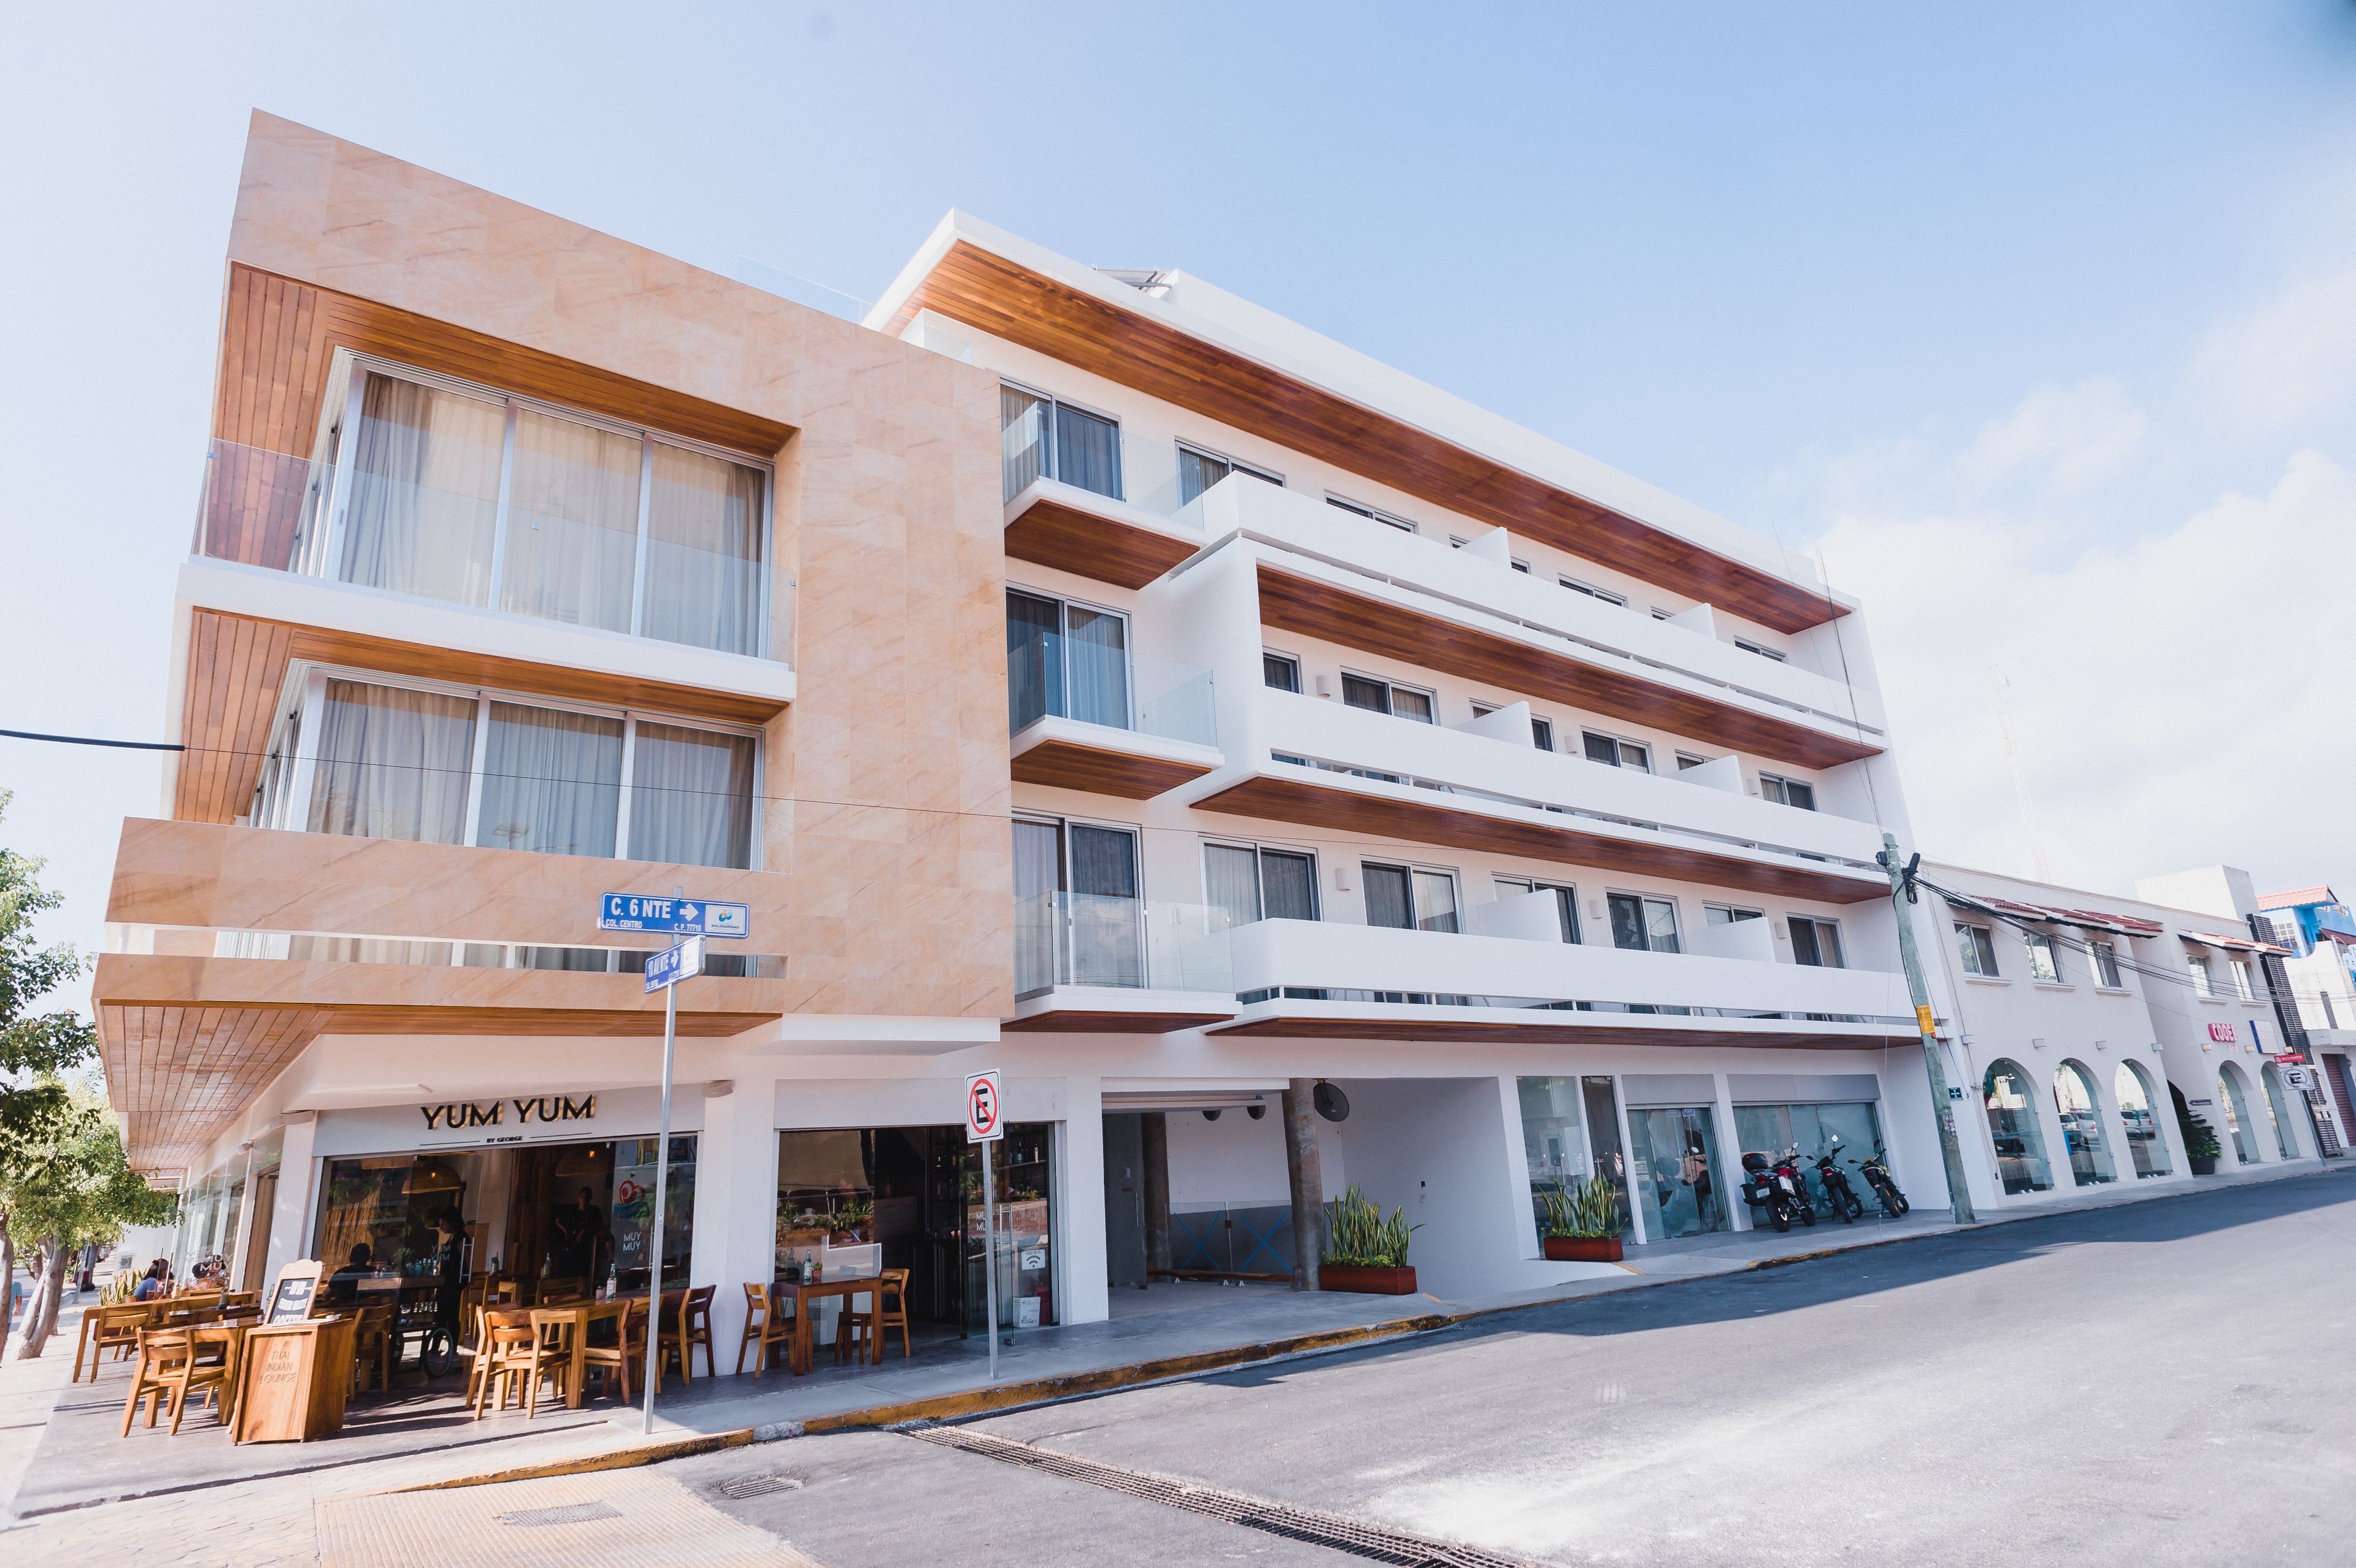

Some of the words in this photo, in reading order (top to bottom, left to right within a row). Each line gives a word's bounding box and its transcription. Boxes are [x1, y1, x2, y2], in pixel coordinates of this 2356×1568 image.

[611, 897, 624, 915] C.
[629, 899, 638, 917] 6
[642, 900, 671, 918] NTE
[620, 920, 642, 929] CENTRO
[976, 1088, 990, 1124] E
[421, 1100, 501, 1130] YUM
[513, 1094, 595, 1123] YUM
[272, 1351, 290, 1359] THAI
[266, 1362, 293, 1371] INDIAN
[259, 1373, 296, 1383] LOUNGE
